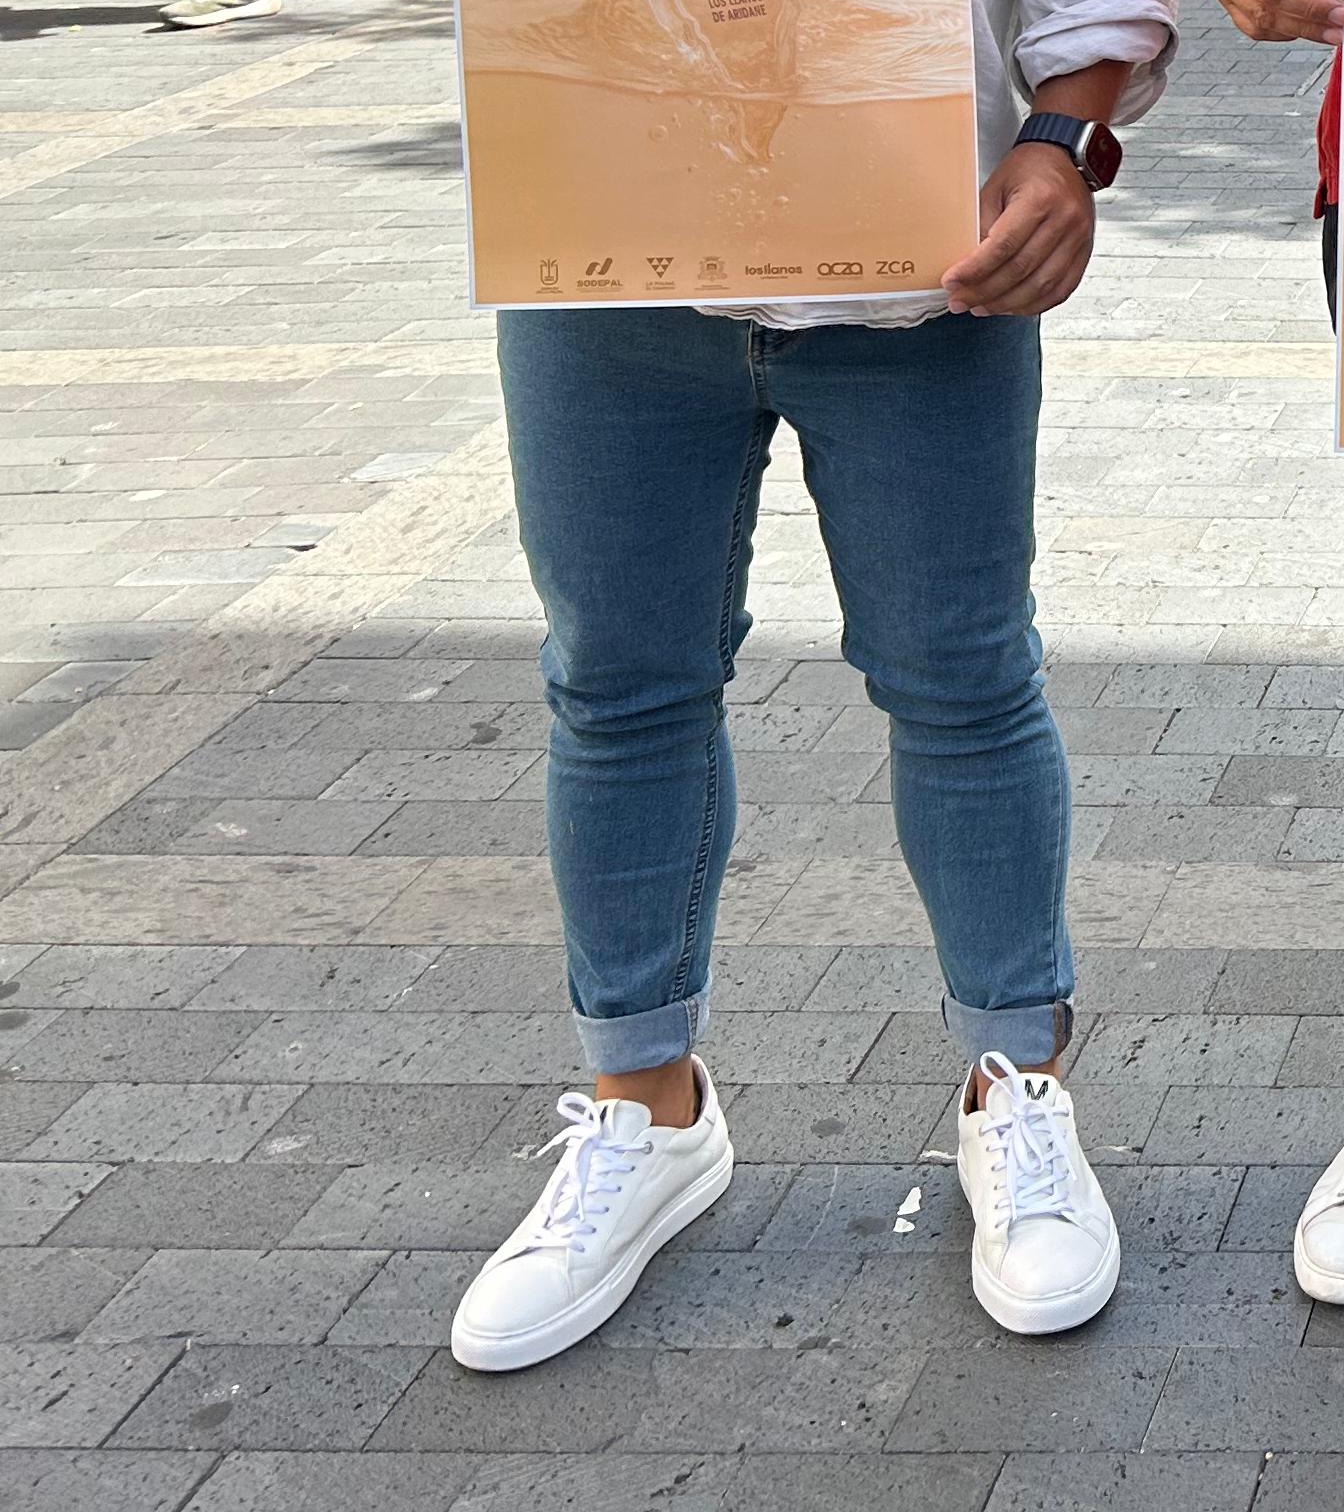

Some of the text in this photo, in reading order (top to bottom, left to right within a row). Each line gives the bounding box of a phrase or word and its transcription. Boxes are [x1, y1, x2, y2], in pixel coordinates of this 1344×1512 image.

[711, 4, 768, 23] DE ARIDANE
[876, 260, 915, 275] ZCA
